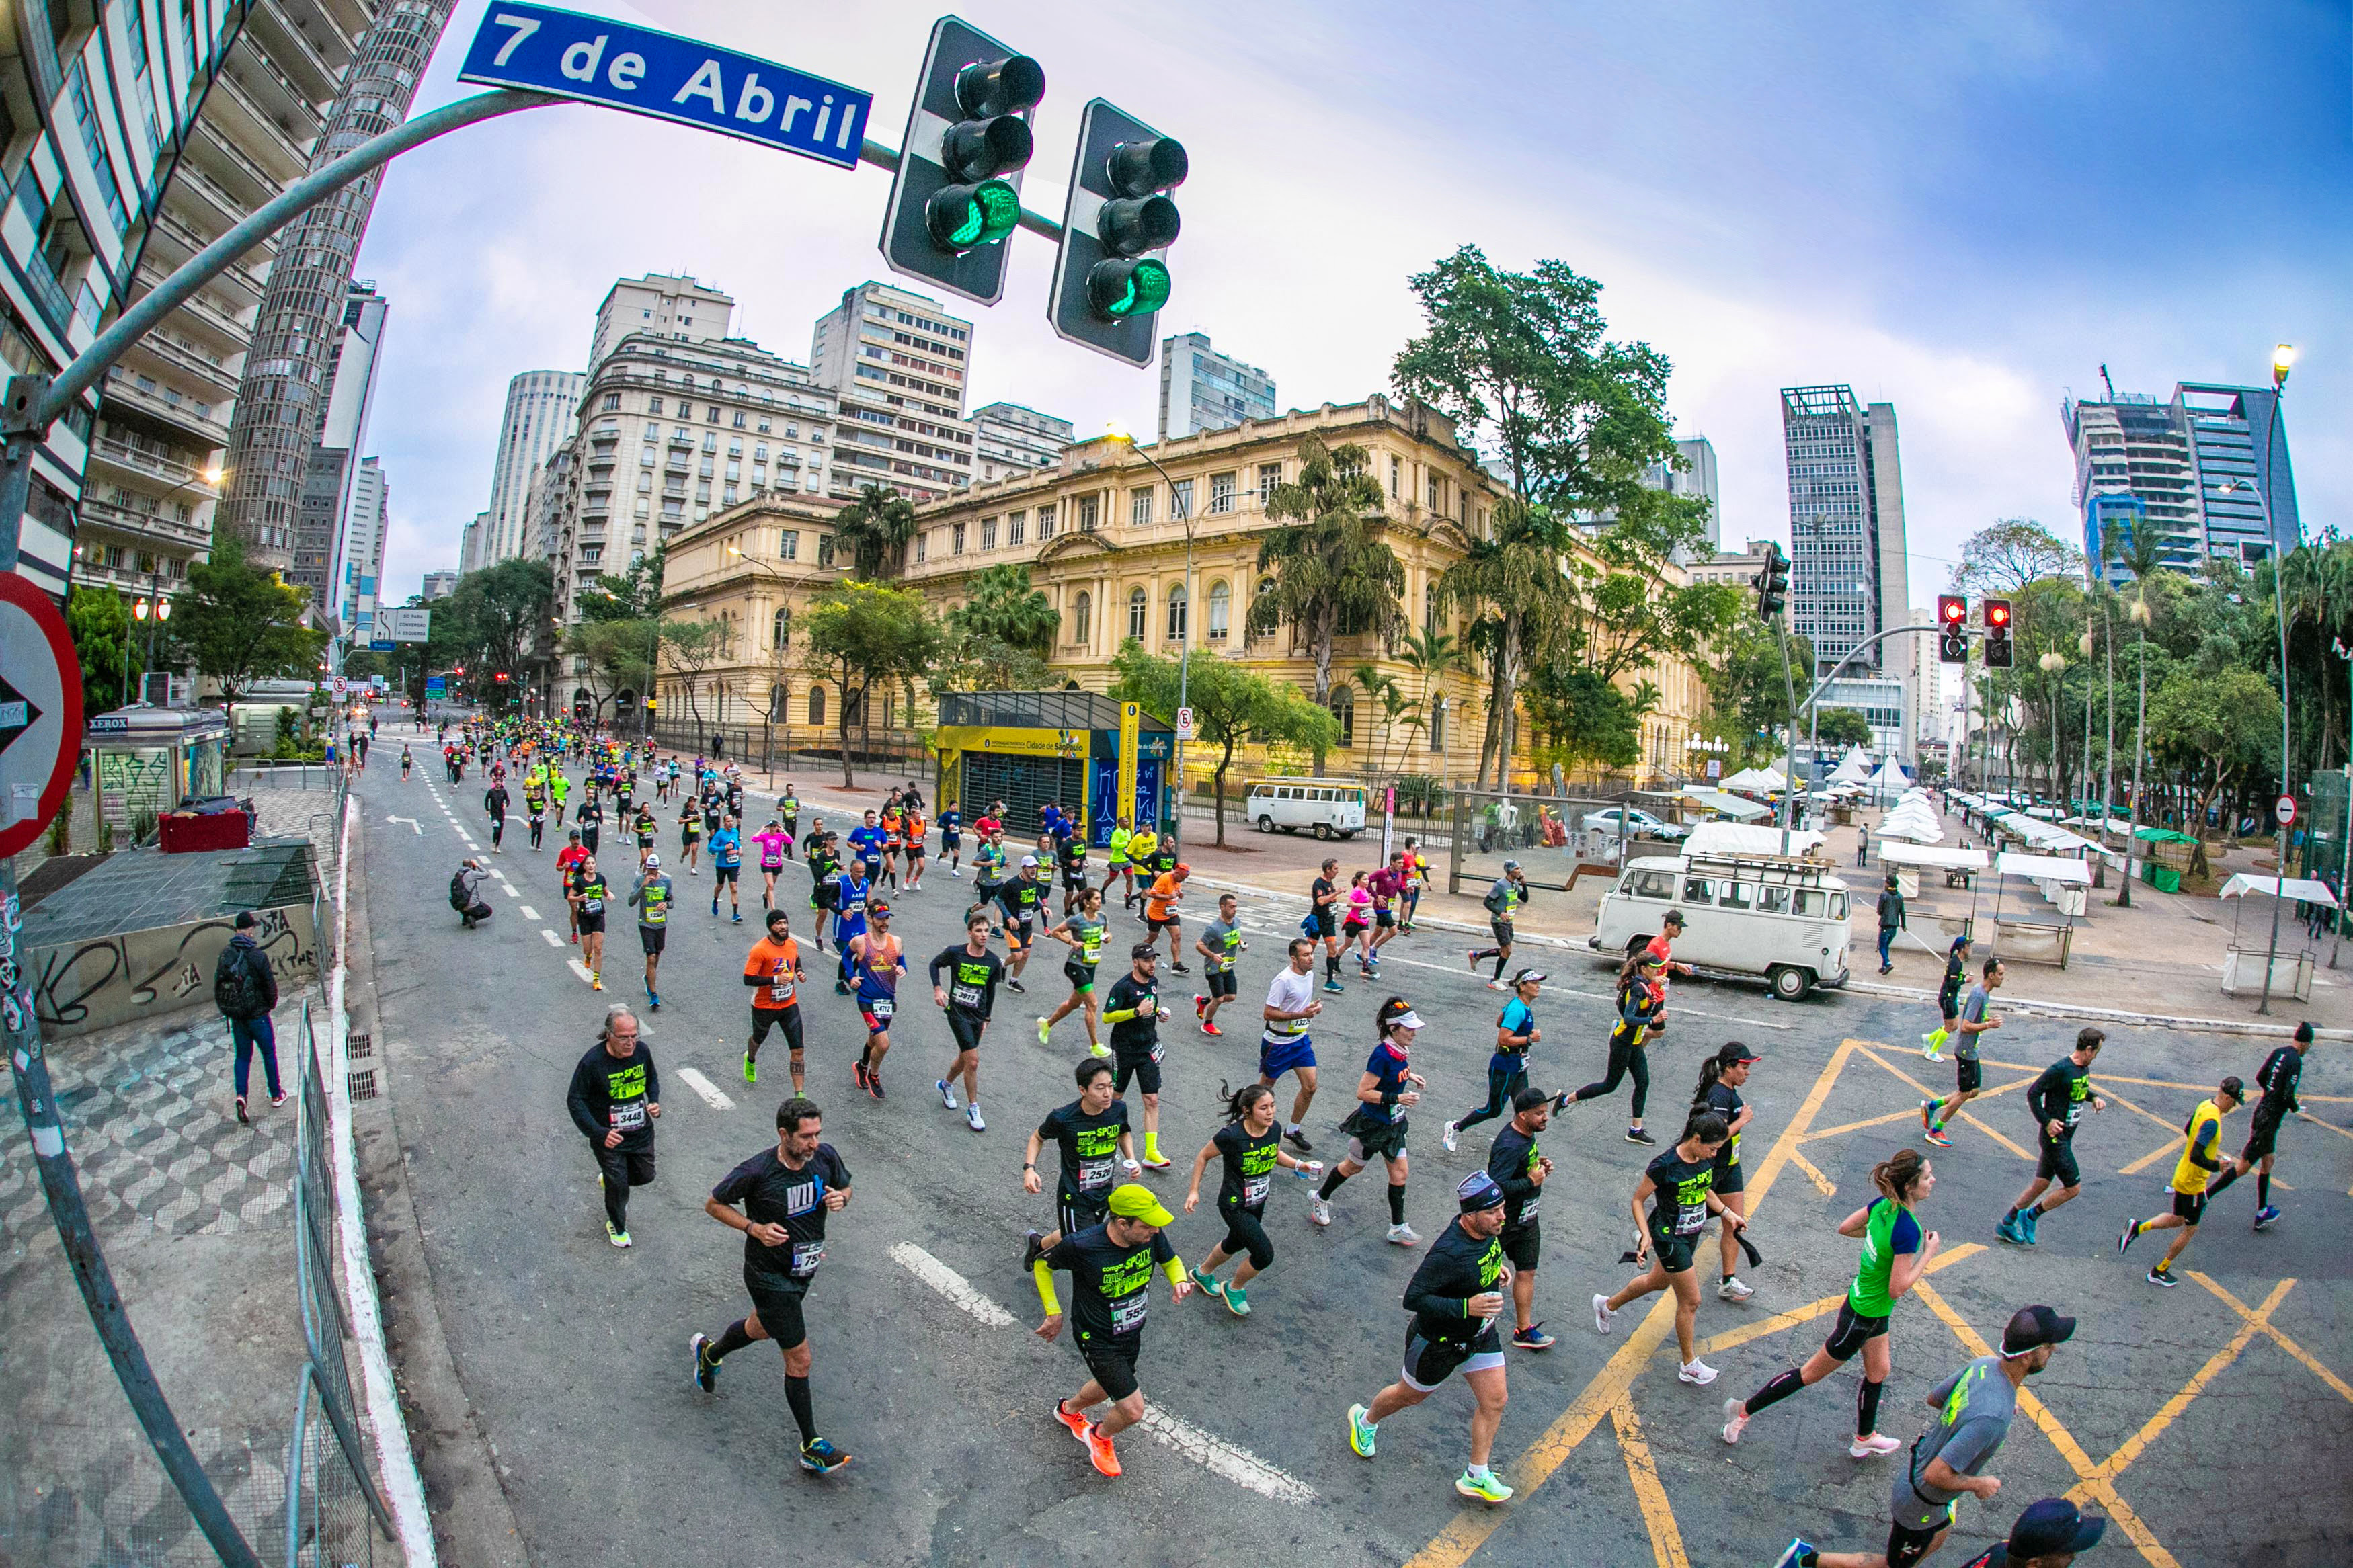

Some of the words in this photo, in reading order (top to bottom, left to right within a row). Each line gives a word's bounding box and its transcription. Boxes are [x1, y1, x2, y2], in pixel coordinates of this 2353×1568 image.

[494, 13, 541, 67] 7
[560, 34, 647, 91] de
[672, 59, 858, 150] Abril
[89, 719, 127, 729] XEROX
[1026, 741, 1045, 749] Cidade
[1046, 742, 1053, 750] de
[959, 991, 975, 1001] 3915
[624, 1063, 644, 1078] SPCITY
[620, 1112, 641, 1123] 3448
[1096, 1124, 1120, 1137] SPCITY
[1125, 1247, 1152, 1270] SPCITY
[1103, 1270, 1125, 1284] HALF
